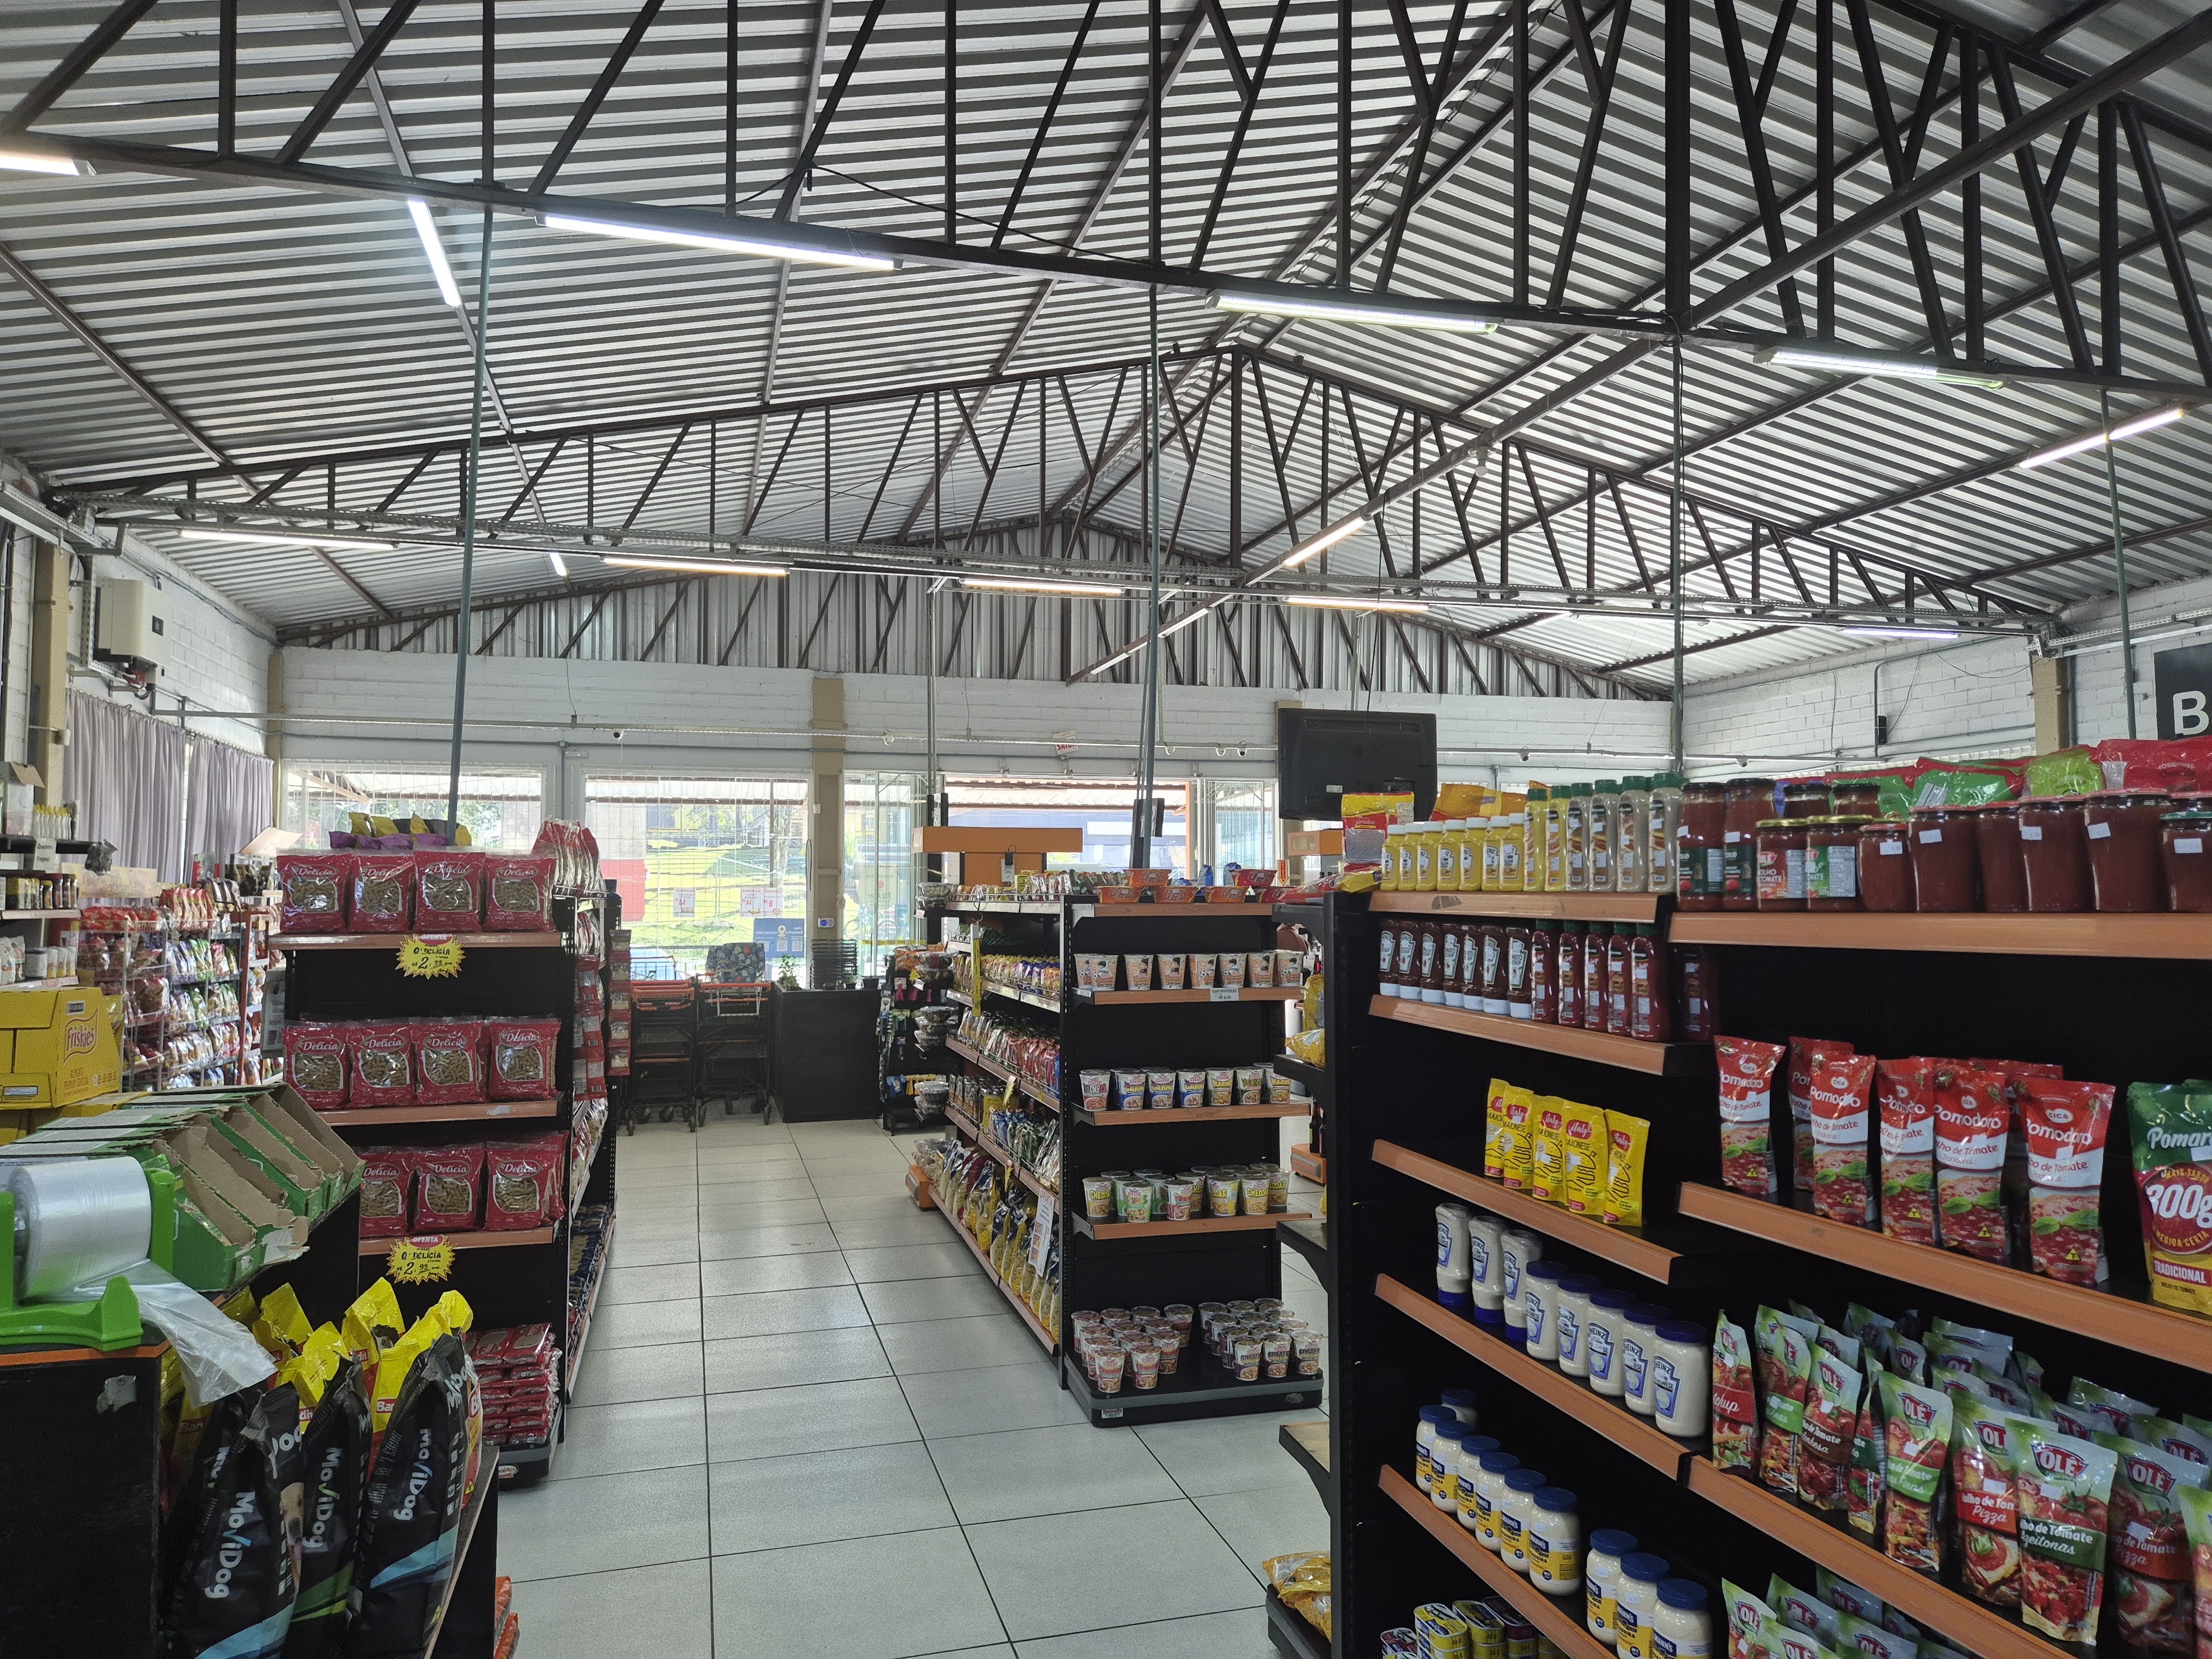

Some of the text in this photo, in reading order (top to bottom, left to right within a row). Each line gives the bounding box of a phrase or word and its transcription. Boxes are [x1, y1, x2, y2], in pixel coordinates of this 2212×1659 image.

[2173, 691, 2209, 735] B
[67, 1026, 95, 1048] Friskies
[1572, 1121, 1592, 1138] italy
[1831, 1121, 1859, 1131] Tomate
[1953, 1145, 1963, 1155] de
[1965, 1145, 1999, 1156] Tomate
[2041, 1162, 2052, 1172] de
[2054, 1161, 2089, 1172] Tomate
[2164, 1167, 2185, 1180] MAIS
[2146, 1184, 2212, 1228] 300g
[2185, 1231, 2210, 1247] CERTA
[2154, 1260, 2207, 1284] TRADICIONAL
[1905, 1397, 1927, 1422] OLÉ
[2039, 1449, 2075, 1477] OLÉ
[2131, 1464, 2164, 1493] OLÉ
[1981, 1495, 1994, 1507] de
[1972, 1506, 2007, 1525] Pizza
[2036, 1521, 2048, 1533] de
[2049, 1524, 2094, 1544] Tomate
[2124, 1536, 2135, 1547] de
